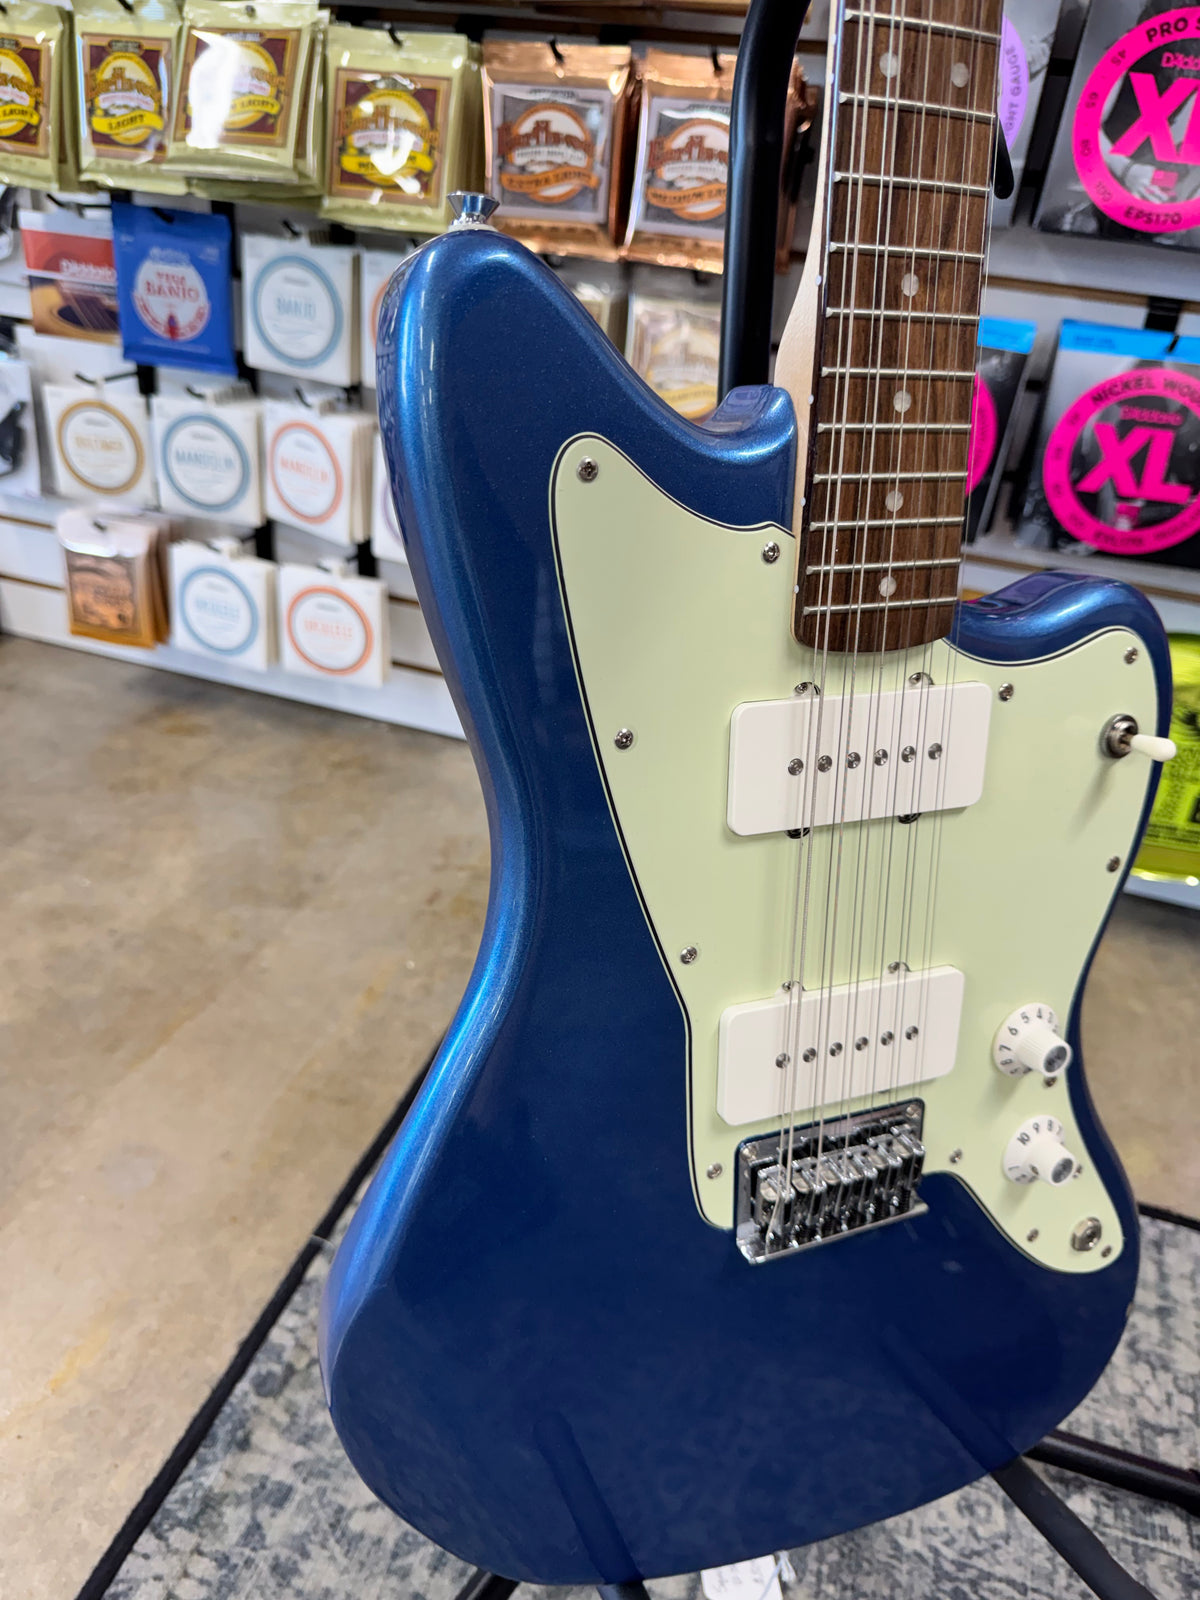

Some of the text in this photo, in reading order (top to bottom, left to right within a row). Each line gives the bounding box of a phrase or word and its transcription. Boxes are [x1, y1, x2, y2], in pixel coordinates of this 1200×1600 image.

[1146, 17, 1189, 42] PRO
[1076, 421, 1192, 504] XL
[1020, 1011, 1030, 1024] 5
[1008, 1026, 1018, 1036] 6
[1000, 1058, 1014, 1066] 8
[1032, 1122, 1040, 1133] 9
[1017, 1131, 1031, 1146] 10
